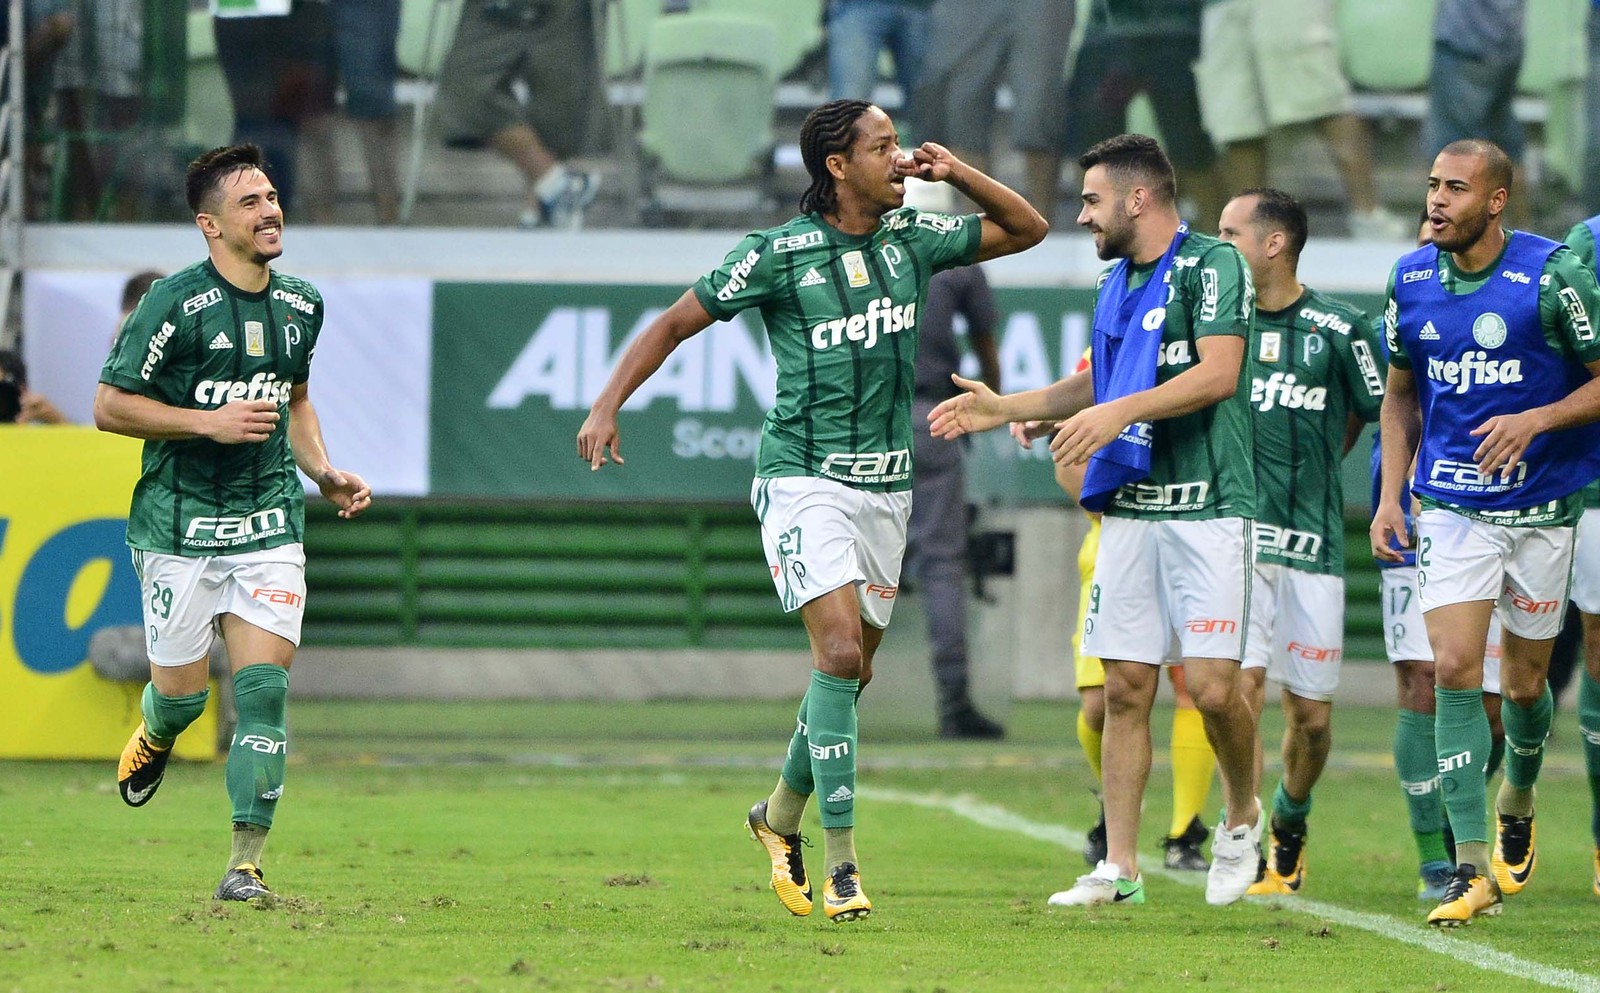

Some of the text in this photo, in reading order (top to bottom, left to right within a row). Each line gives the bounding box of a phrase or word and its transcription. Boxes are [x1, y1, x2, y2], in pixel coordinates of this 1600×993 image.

[717, 249, 761, 302] crefisa
[272, 289, 315, 316] crefisa
[811, 297, 916, 350] crefisa
[140, 320, 177, 382] crefisa
[1250, 372, 1327, 412] efisa
[864, 475, 880, 484] DAS
[1467, 485, 1485, 493] DAS
[1495, 517, 1513, 526] DAS
[183, 538, 230, 548] FACULDADE
[231, 536, 248, 546] DAS
[778, 525, 802, 557] 27
[151, 581, 174, 620] 29
[1390, 586, 1413, 616] 17
